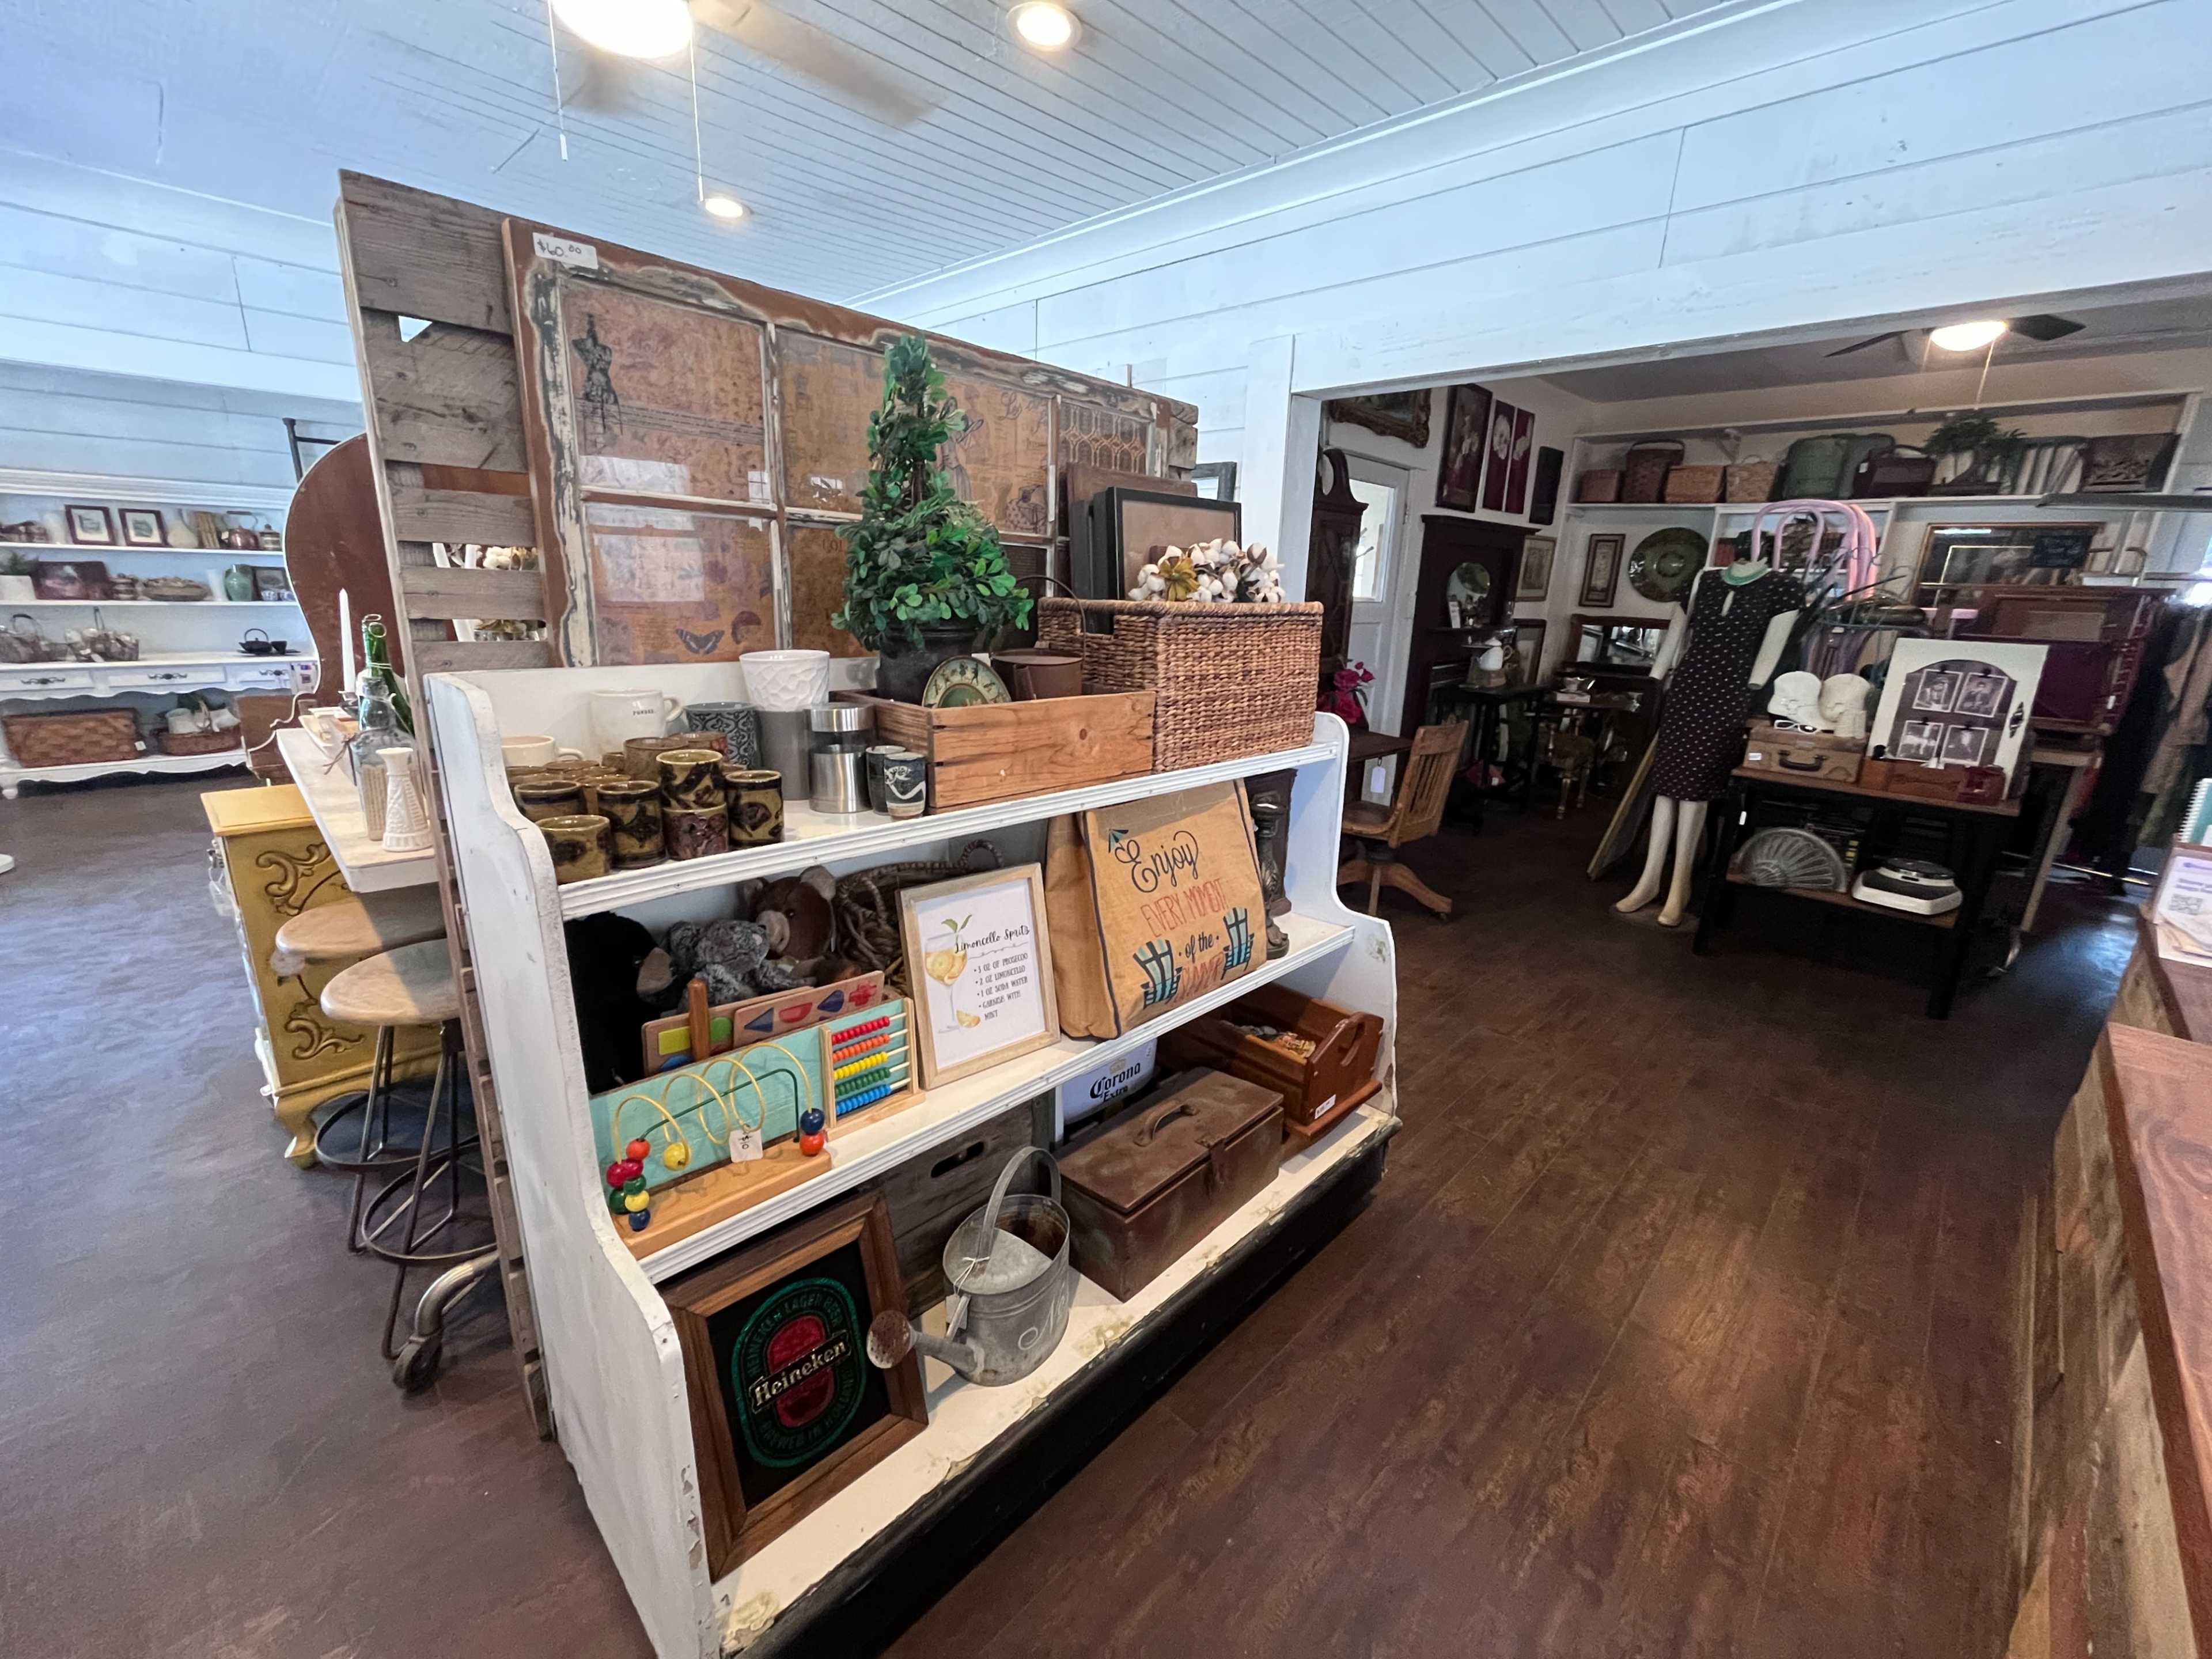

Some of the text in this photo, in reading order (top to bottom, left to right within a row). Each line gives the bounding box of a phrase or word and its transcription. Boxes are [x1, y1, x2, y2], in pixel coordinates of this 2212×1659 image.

[1115, 831, 1199, 893] Enjoy
[1140, 892, 1187, 938] EVERY
[955, 925, 1030, 954] Limoncello Spritz
[1185, 931, 1214, 964] of the
[979, 978, 983, 986] 2
[1010, 976, 1028, 987] WATER
[1090, 1063, 1141, 1099] Corona
[1103, 1085, 1128, 1103] Extra
[755, 1341, 847, 1407] Heineken
